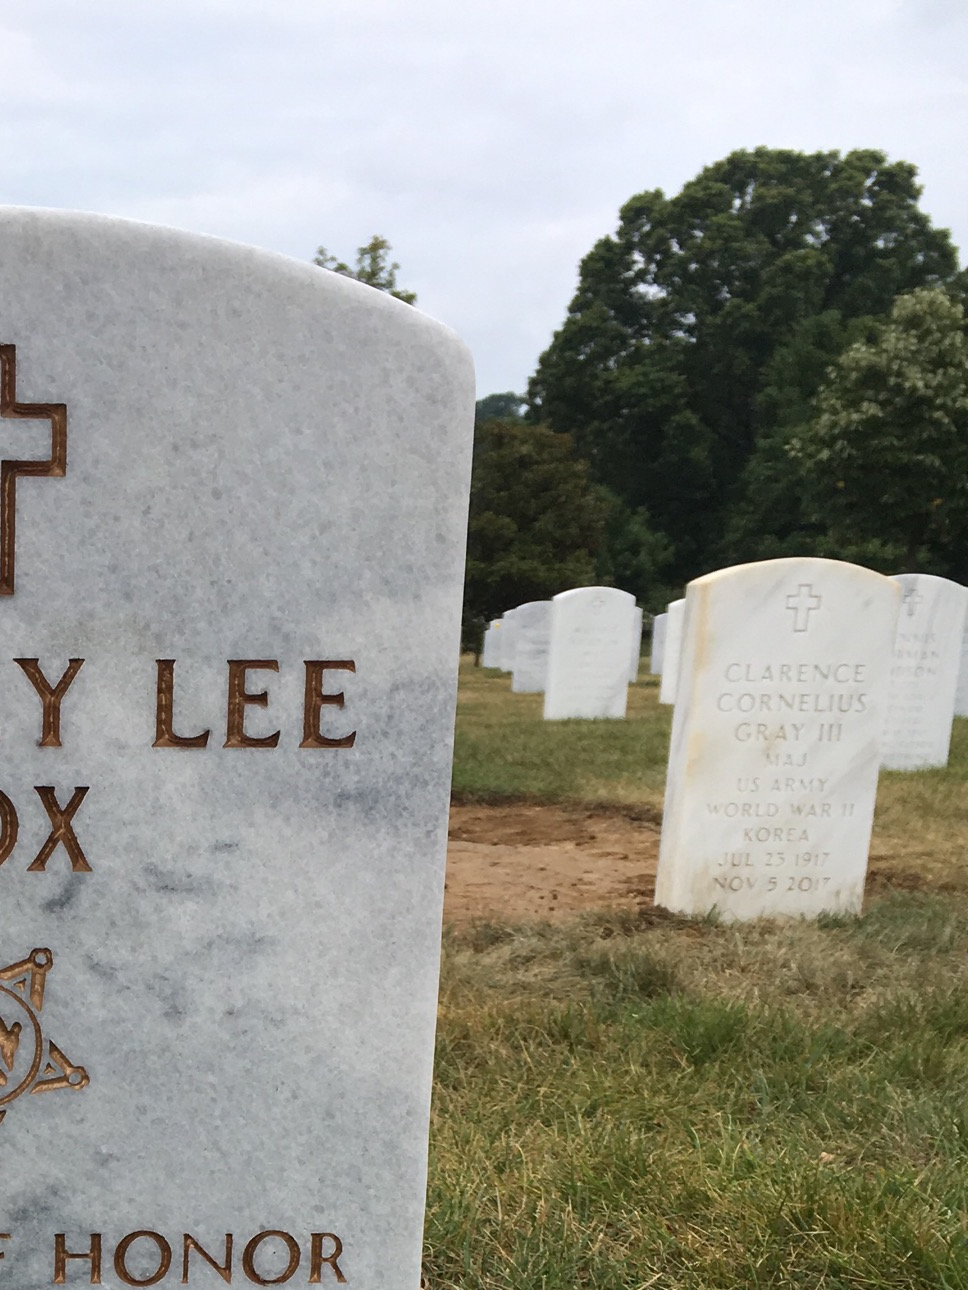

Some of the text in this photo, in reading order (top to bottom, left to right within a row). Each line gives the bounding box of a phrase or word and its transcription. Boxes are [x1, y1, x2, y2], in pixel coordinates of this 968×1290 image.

[724, 662, 867, 683] CLARENCE
[151, 659, 356, 749] LEE
[716, 692, 868, 713] CORNELIUS
[734, 722, 843, 742] GRAY III
[764, 752, 808, 767] MAJ
[736, 777, 830, 793] US ARMY
[705, 802, 780, 817] WORLD
[789, 803, 832, 817] WAR
[743, 827, 810, 842] KOREA
[717, 852, 831, 867] JUL 23 1917
[712, 876, 831, 892] NOV 5 2017
[53, 1229, 347, 1287] HONOR
